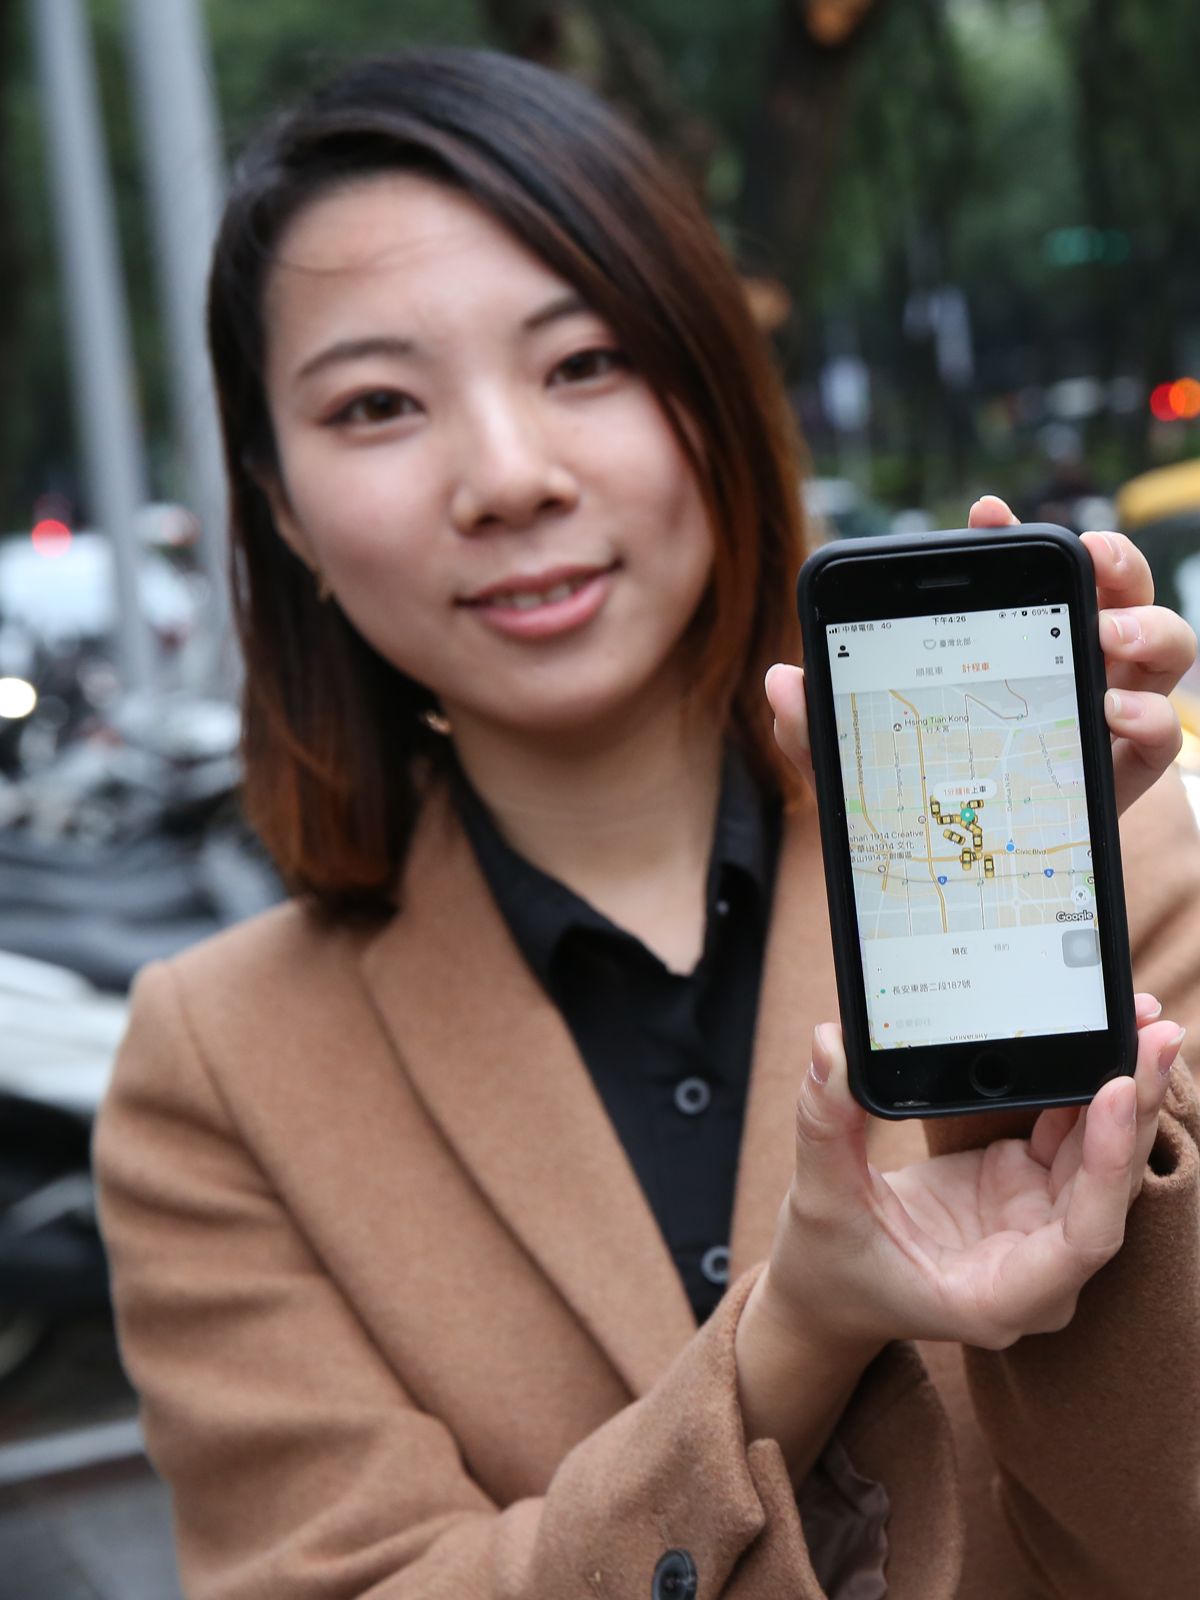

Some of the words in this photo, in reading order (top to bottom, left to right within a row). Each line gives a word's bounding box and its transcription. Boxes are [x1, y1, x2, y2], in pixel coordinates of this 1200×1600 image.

[842, 623, 874, 634] 中華電信
[881, 622, 892, 630] 4G
[961, 661, 990, 674] 計程車
[904, 718, 928, 727] Hsing
[931, 716, 947, 724] Tian
[948, 714, 969, 723] Kong
[891, 830, 924, 839] Creative
[1056, 909, 1094, 922] Google
[893, 980, 971, 995] 長安東路二段187號
